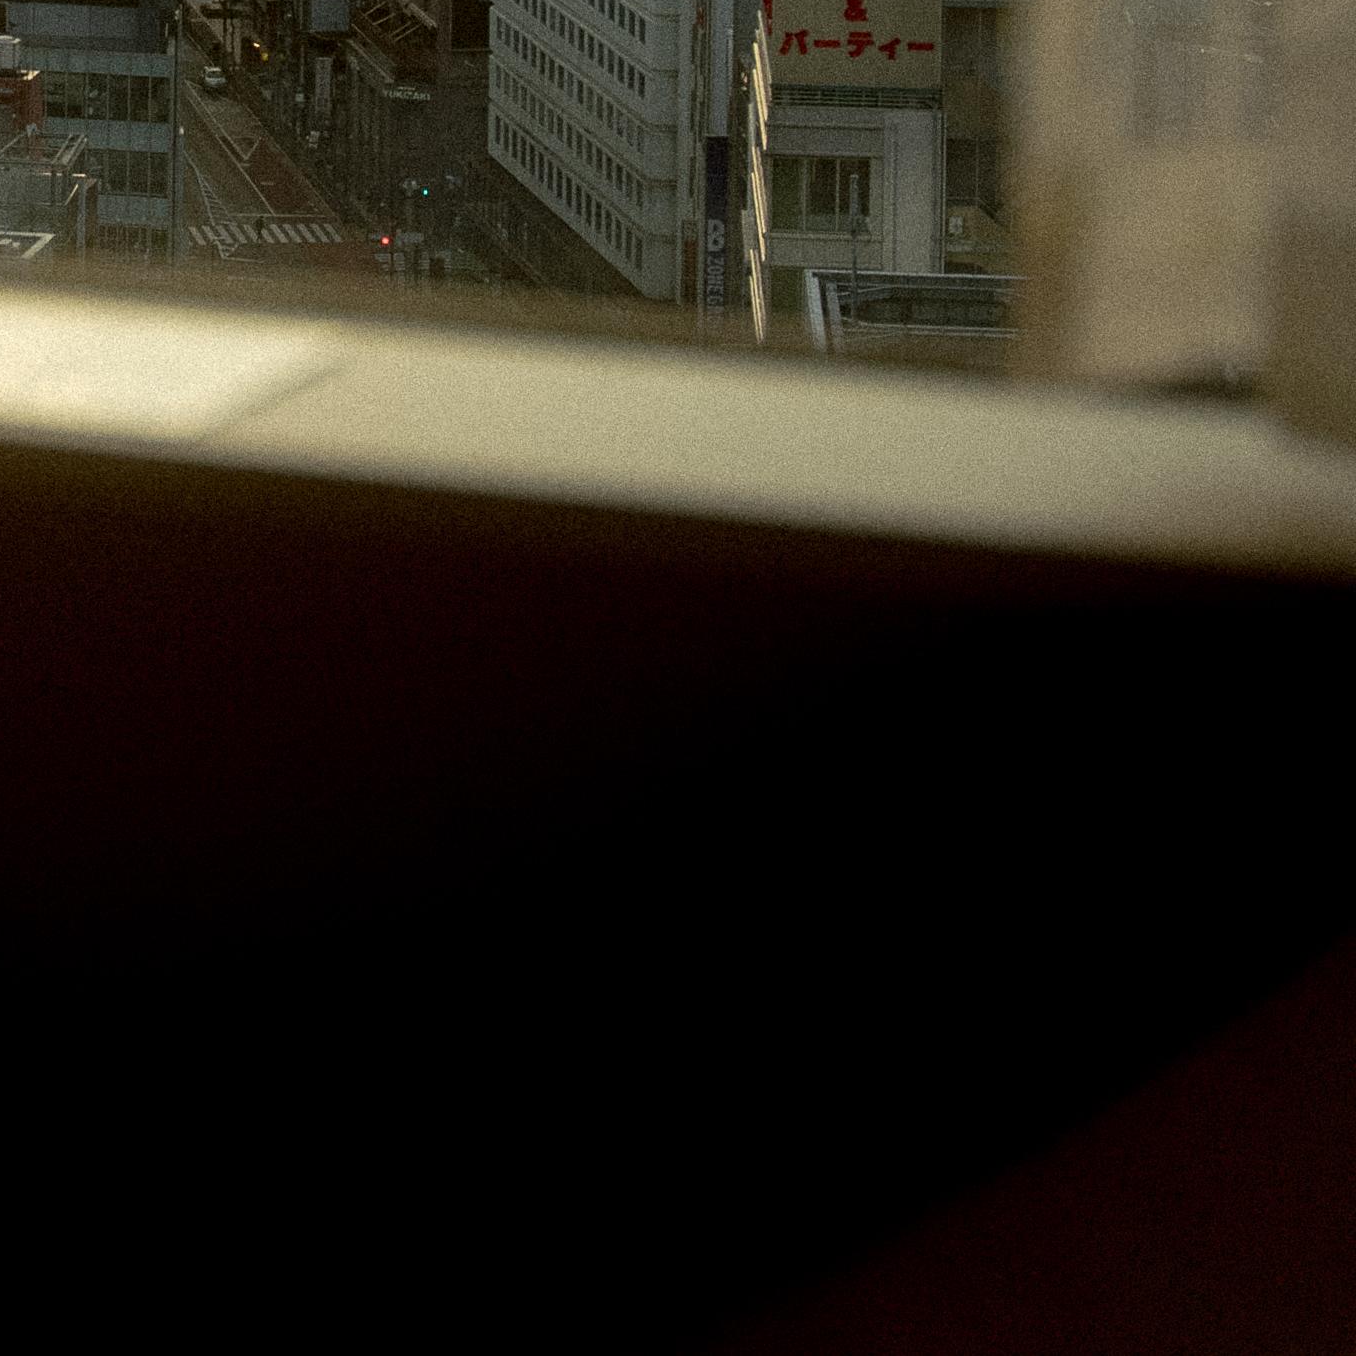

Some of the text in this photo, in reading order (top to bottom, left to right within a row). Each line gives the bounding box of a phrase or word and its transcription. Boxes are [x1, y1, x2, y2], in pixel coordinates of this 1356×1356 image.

[779, 29, 935, 61] パーティー
